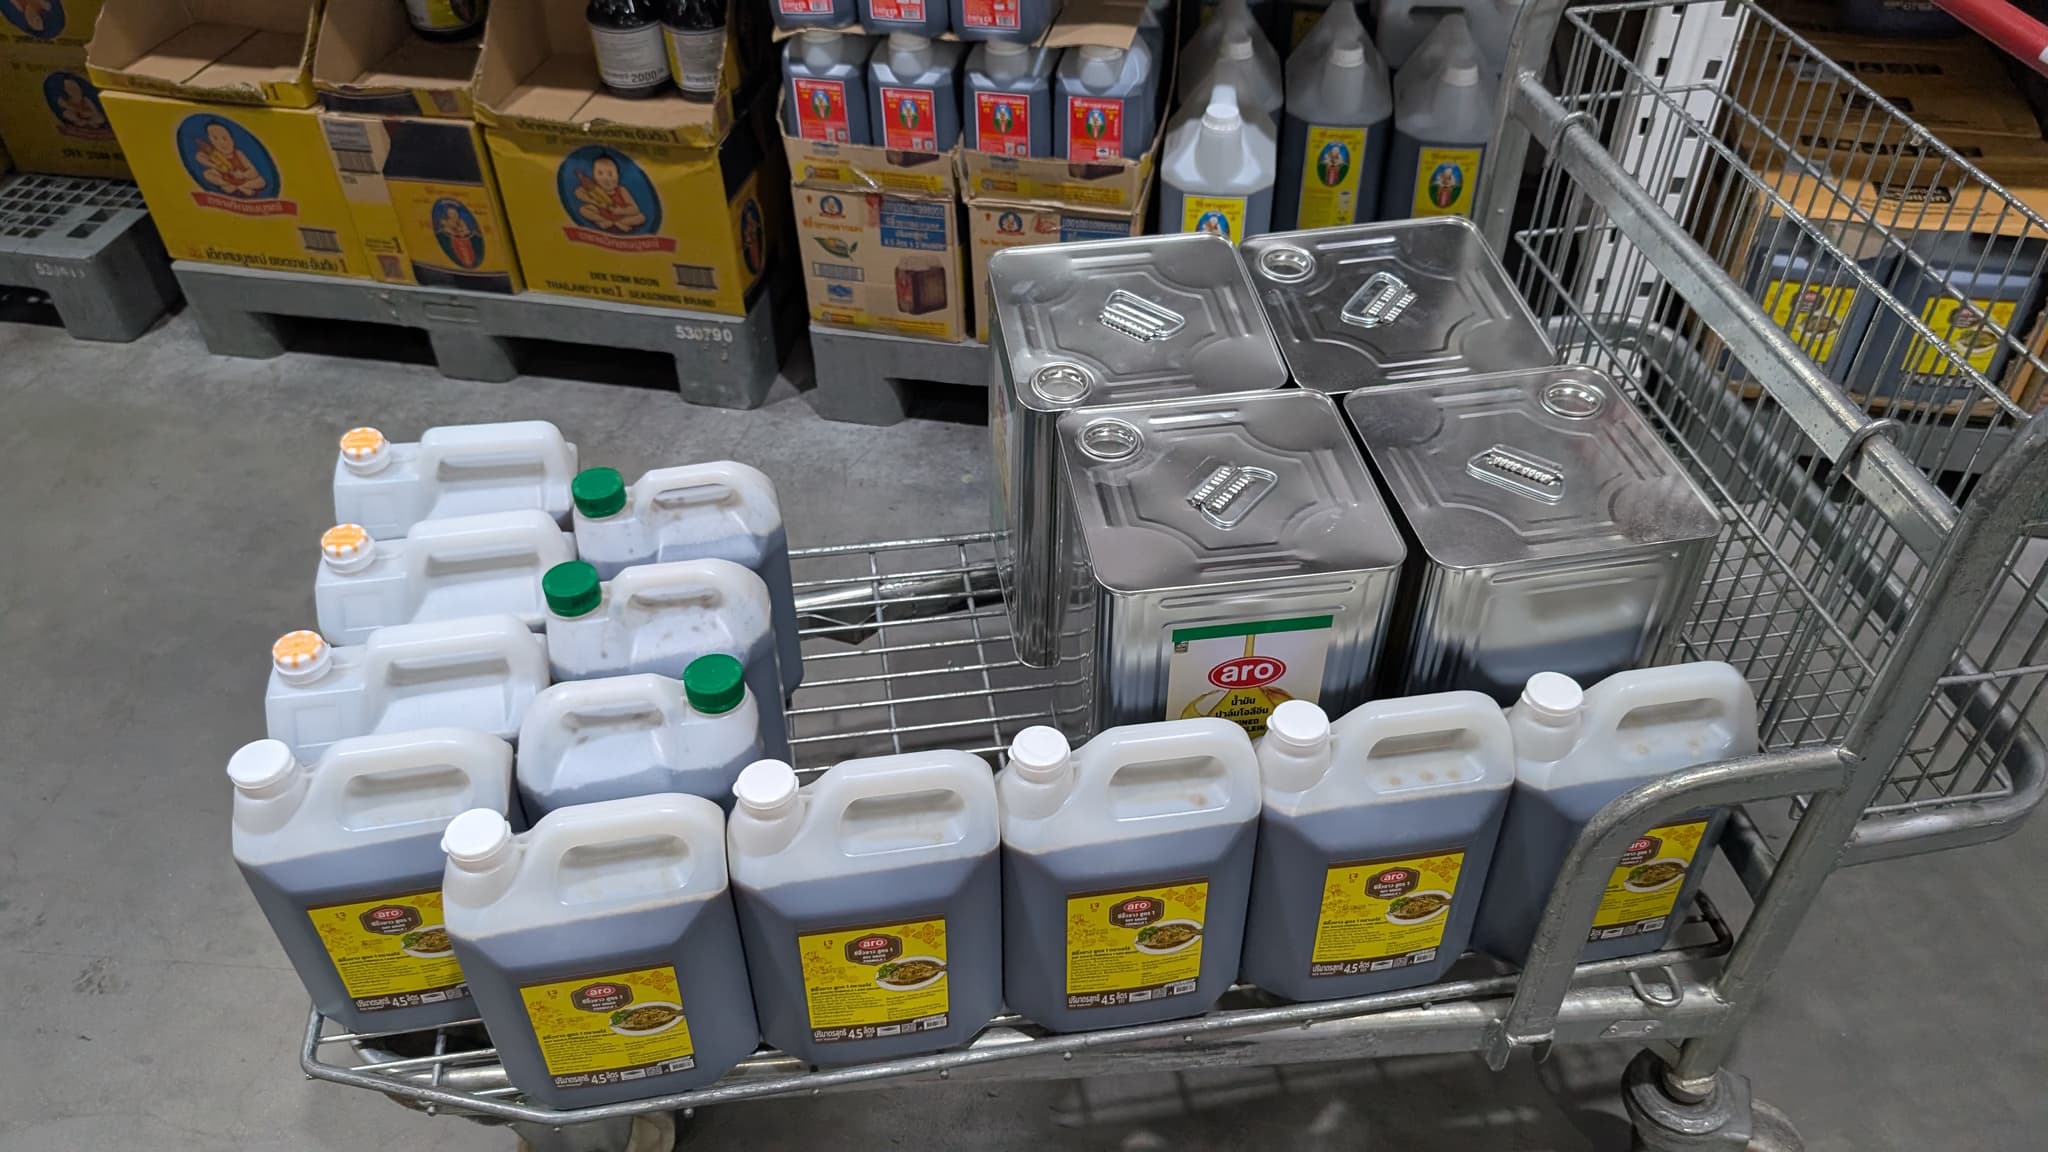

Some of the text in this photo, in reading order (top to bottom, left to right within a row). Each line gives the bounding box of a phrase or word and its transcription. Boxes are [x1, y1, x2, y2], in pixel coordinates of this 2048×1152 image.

[631, 70, 657, 83] 2000
[675, 325, 733, 343] 530790
[1220, 662, 1274, 682] aro
[1231, 694, 1256, 706] น้ำมัน
[1630, 841, 1648, 849] ro
[1384, 873, 1404, 881] aro
[1127, 902, 1148, 910] aro
[378, 910, 399, 918] aro
[863, 939, 884, 947] aro
[1344, 963, 1358, 974] 4.5
[590, 987, 611, 996] aro
[393, 997, 408, 1007] 4.5
[1101, 994, 1116, 1005] 4.5
[848, 1028, 863, 1039] 4.5
[591, 1074, 607, 1084] 4.5
